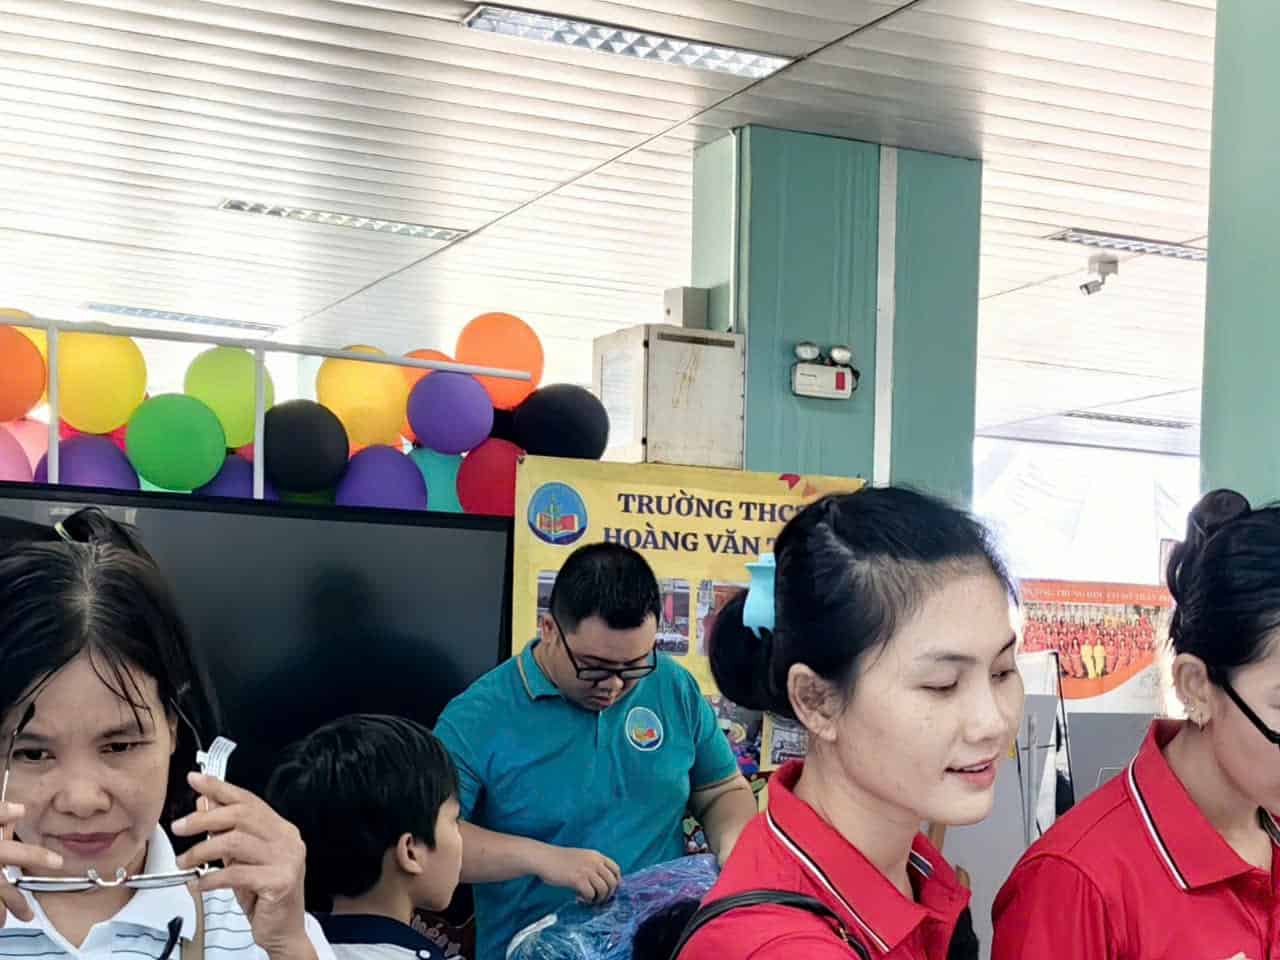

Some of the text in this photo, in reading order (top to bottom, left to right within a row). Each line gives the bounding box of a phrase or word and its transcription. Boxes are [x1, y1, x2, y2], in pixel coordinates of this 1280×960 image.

[617, 489, 733, 519] TRƯỜNG
[602, 522, 760, 556] HOÀNG VĂN
